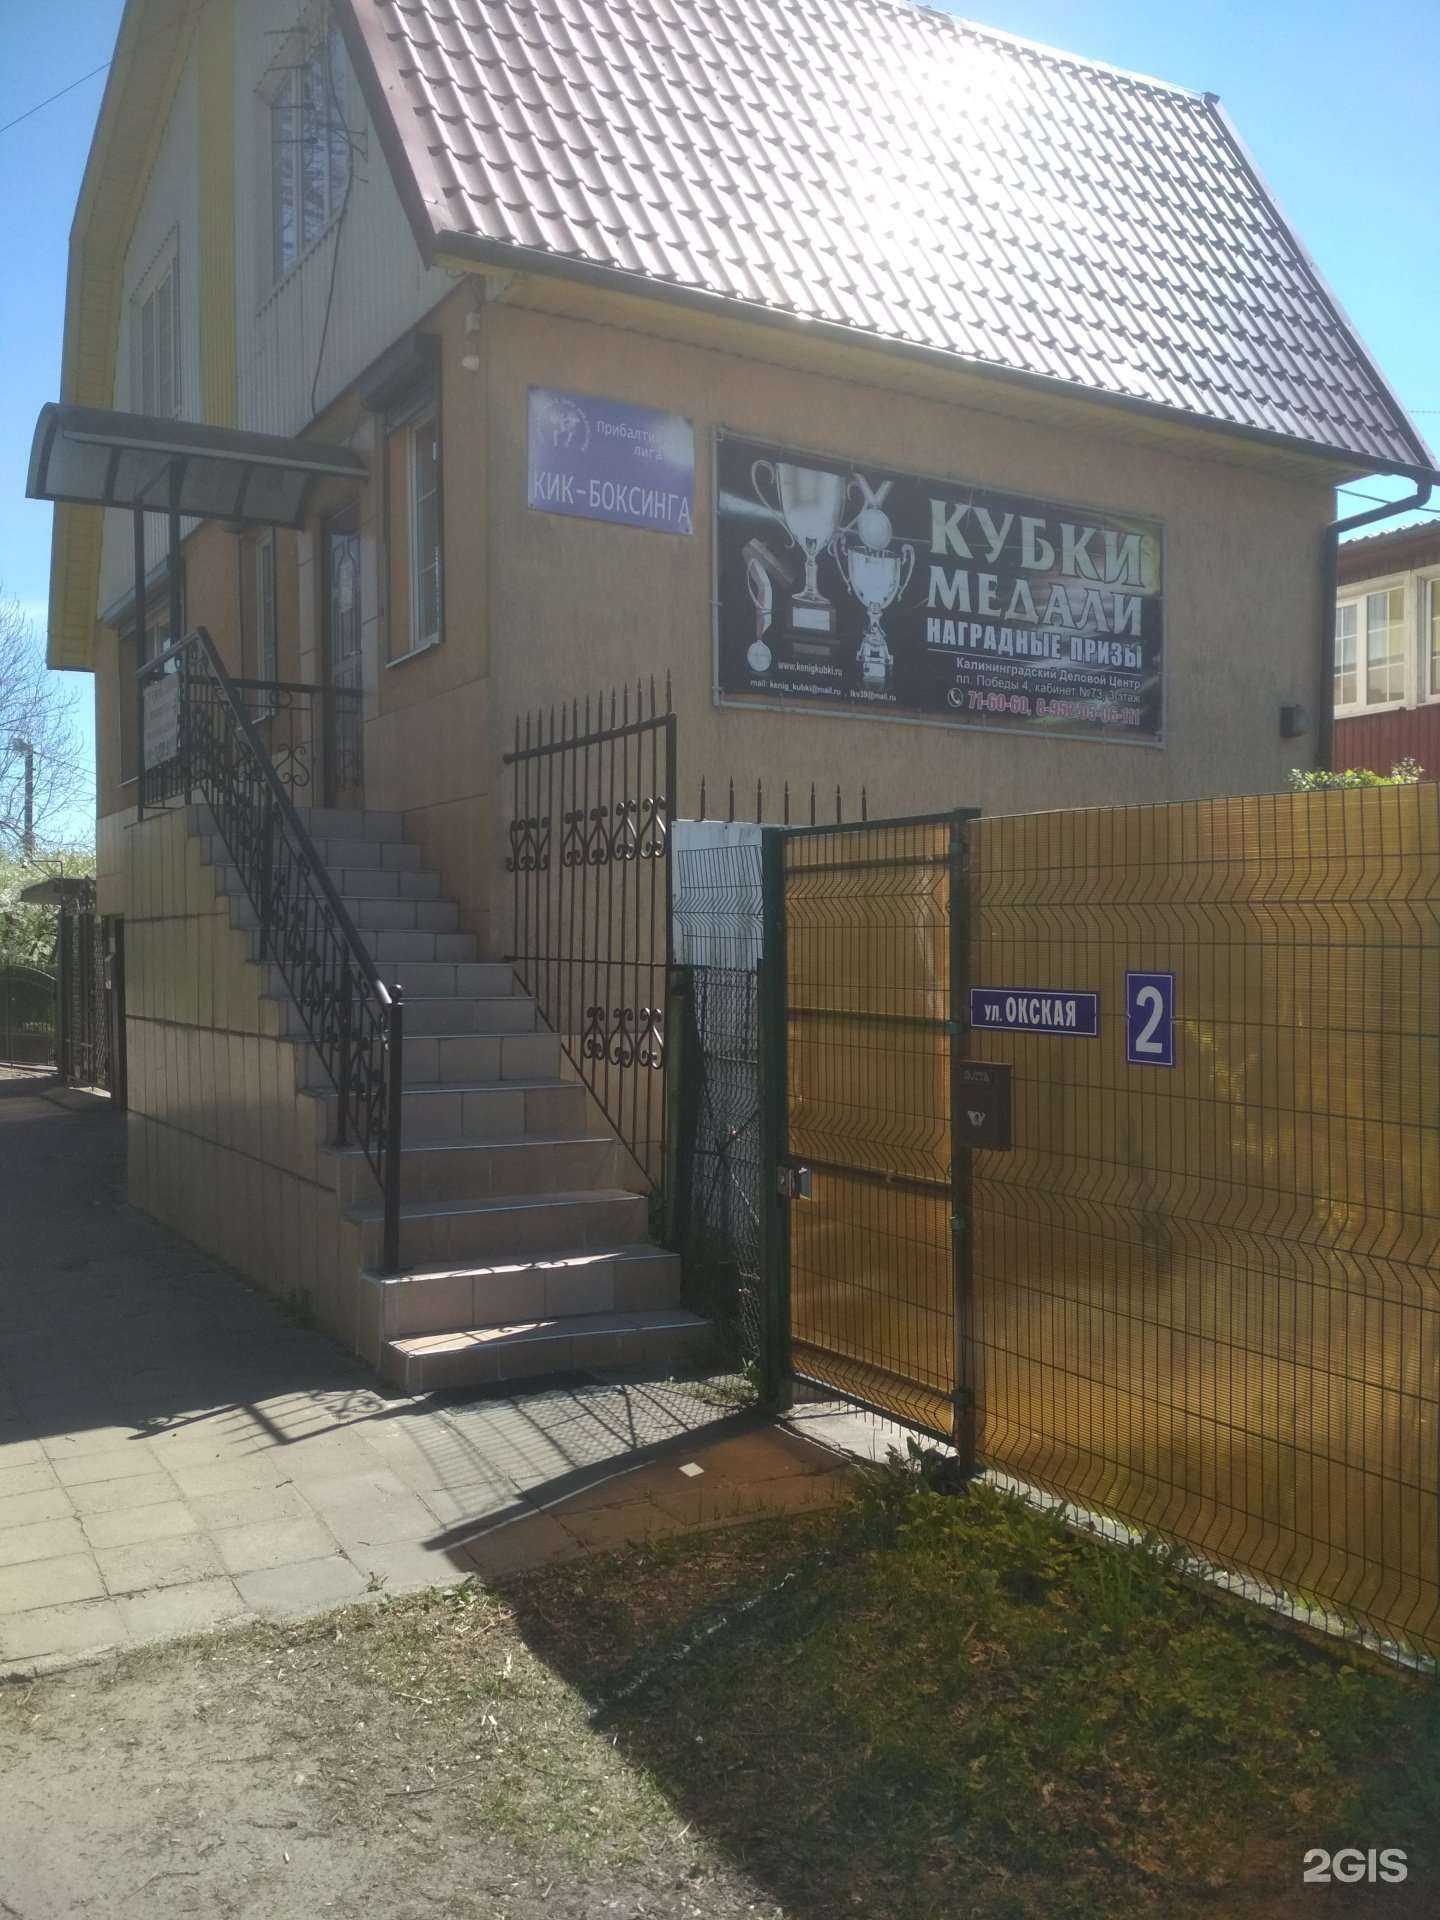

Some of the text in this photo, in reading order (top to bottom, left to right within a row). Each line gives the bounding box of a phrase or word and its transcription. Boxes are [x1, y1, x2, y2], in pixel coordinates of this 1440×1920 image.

[534, 472, 693, 536] КИК-БОКСИНГА
[929, 498, 1145, 587] КУБКИ
[927, 565, 1143, 636] МЕДАЛИ
[927, 617, 1142, 669] НАГРАДНЫЕ ПРИЗЫ
[956, 657, 1141, 691] Калининградский Деловой Центр
[976, 675, 1019, 690] Победы
[1035, 683, 1075, 697] кабинет
[984, 996, 1076, 1027] ул. ОКСКАЯ
[1135, 985, 1164, 1054] 2
